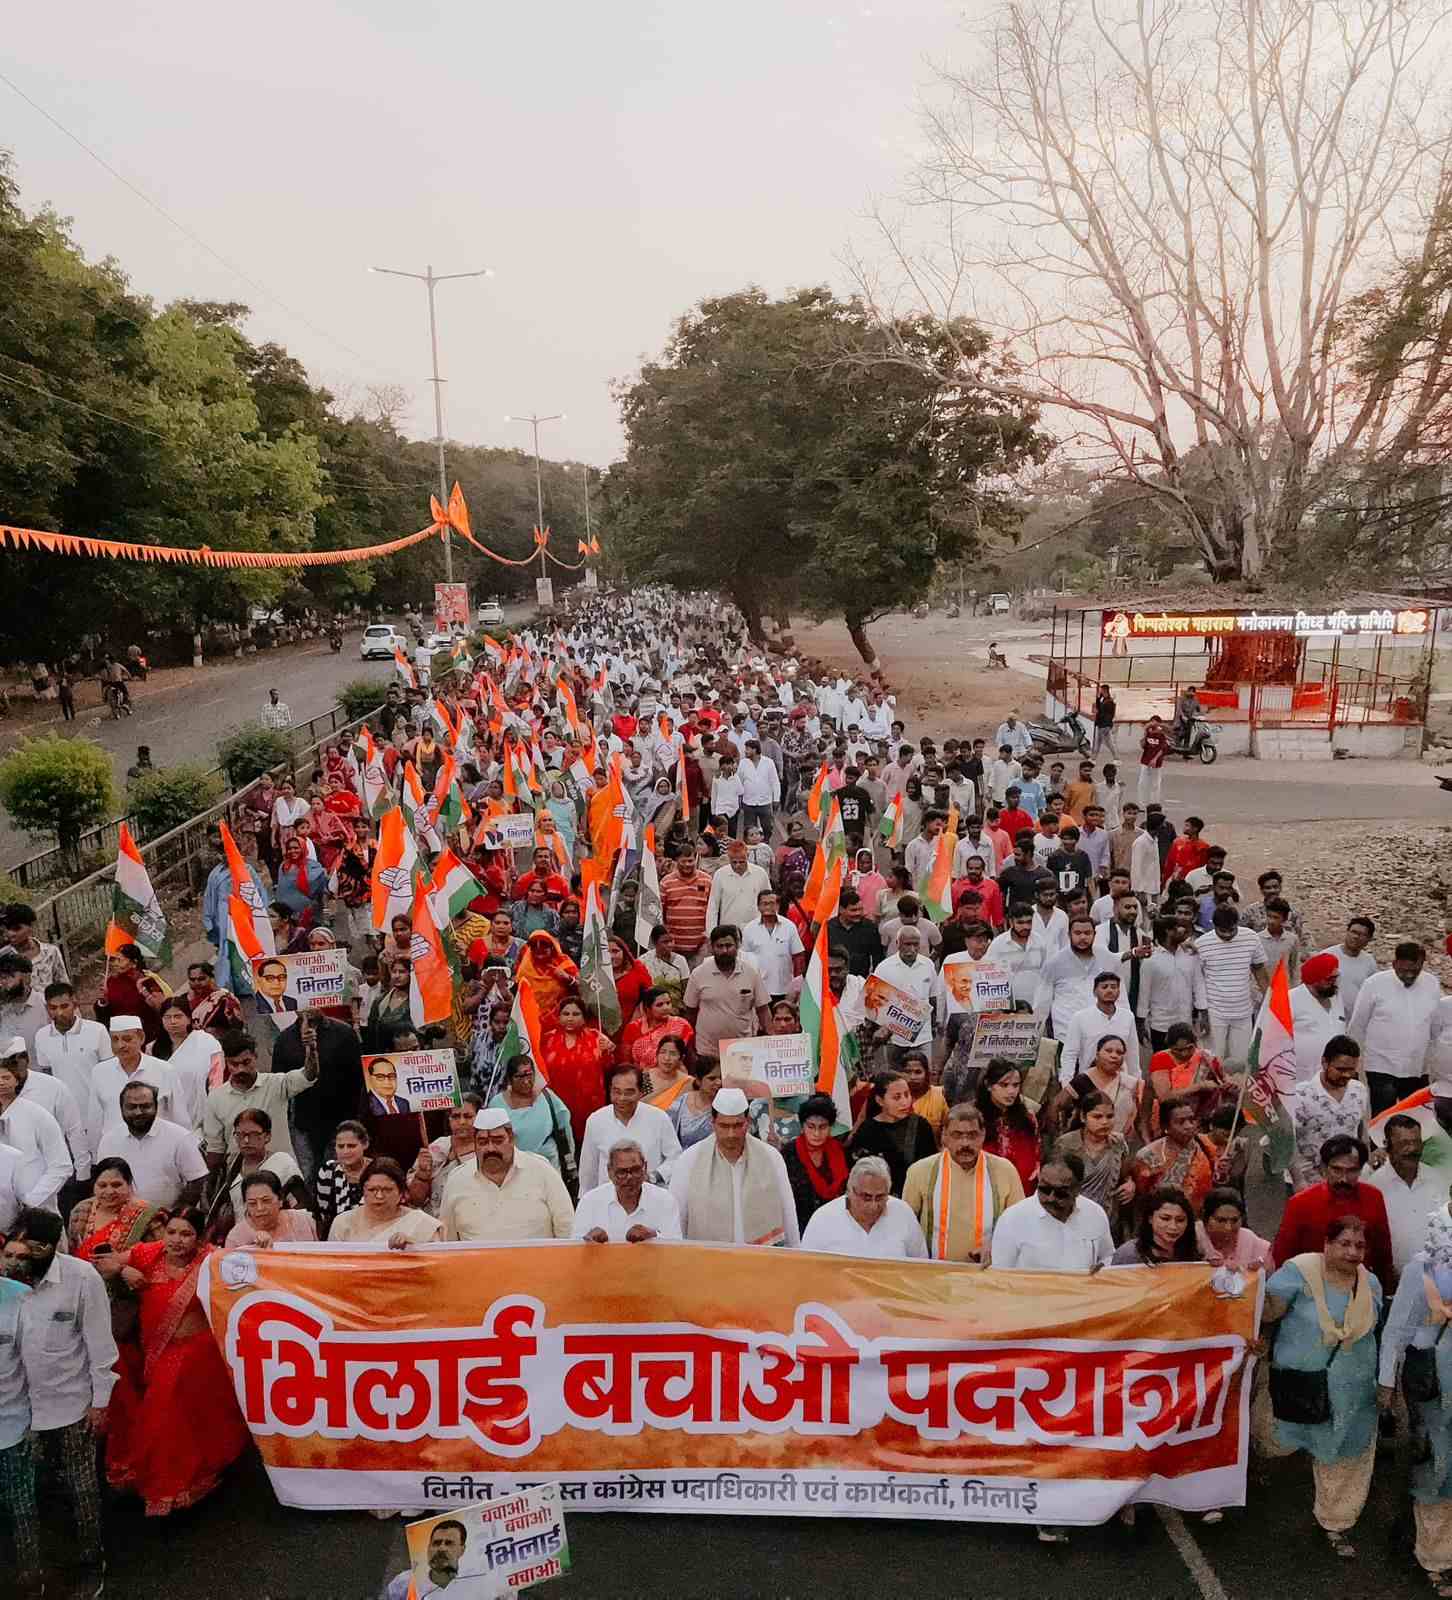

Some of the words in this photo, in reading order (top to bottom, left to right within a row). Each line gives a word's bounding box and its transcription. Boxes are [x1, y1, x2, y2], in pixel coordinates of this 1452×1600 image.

[1191, 616, 1234, 632] महाराज
[1236, 611, 1294, 631] मनोकामना
[1327, 610, 1357, 630] मंदिर
[1358, 609, 1394, 629] समिति
[842, 804, 859, 820] 23
[296, 974, 344, 994] भिलाई
[764, 1059, 811, 1079] भिलाई
[406, 1075, 454, 1095] भिलाई
[236, 1300, 538, 1446] भिलाई
[562, 1314, 860, 1424] बचाओ
[880, 1344, 1235, 1438] पदयात्रा
[422, 1475, 494, 1500] विनीत
[593, 1474, 666, 1499] कांग्रेस
[671, 1472, 797, 1502] पदाधिकारी
[803, 1475, 840, 1502] एवं
[844, 1475, 955, 1509] कार्यकर्ता,
[963, 1479, 1039, 1514] भिलाई
[481, 1497, 529, 1524] बचाओ!
[504, 1506, 553, 1533] बचाओ!
[484, 1523, 561, 1570] भिलाई
[506, 1558, 561, 1588] बचाओ!
